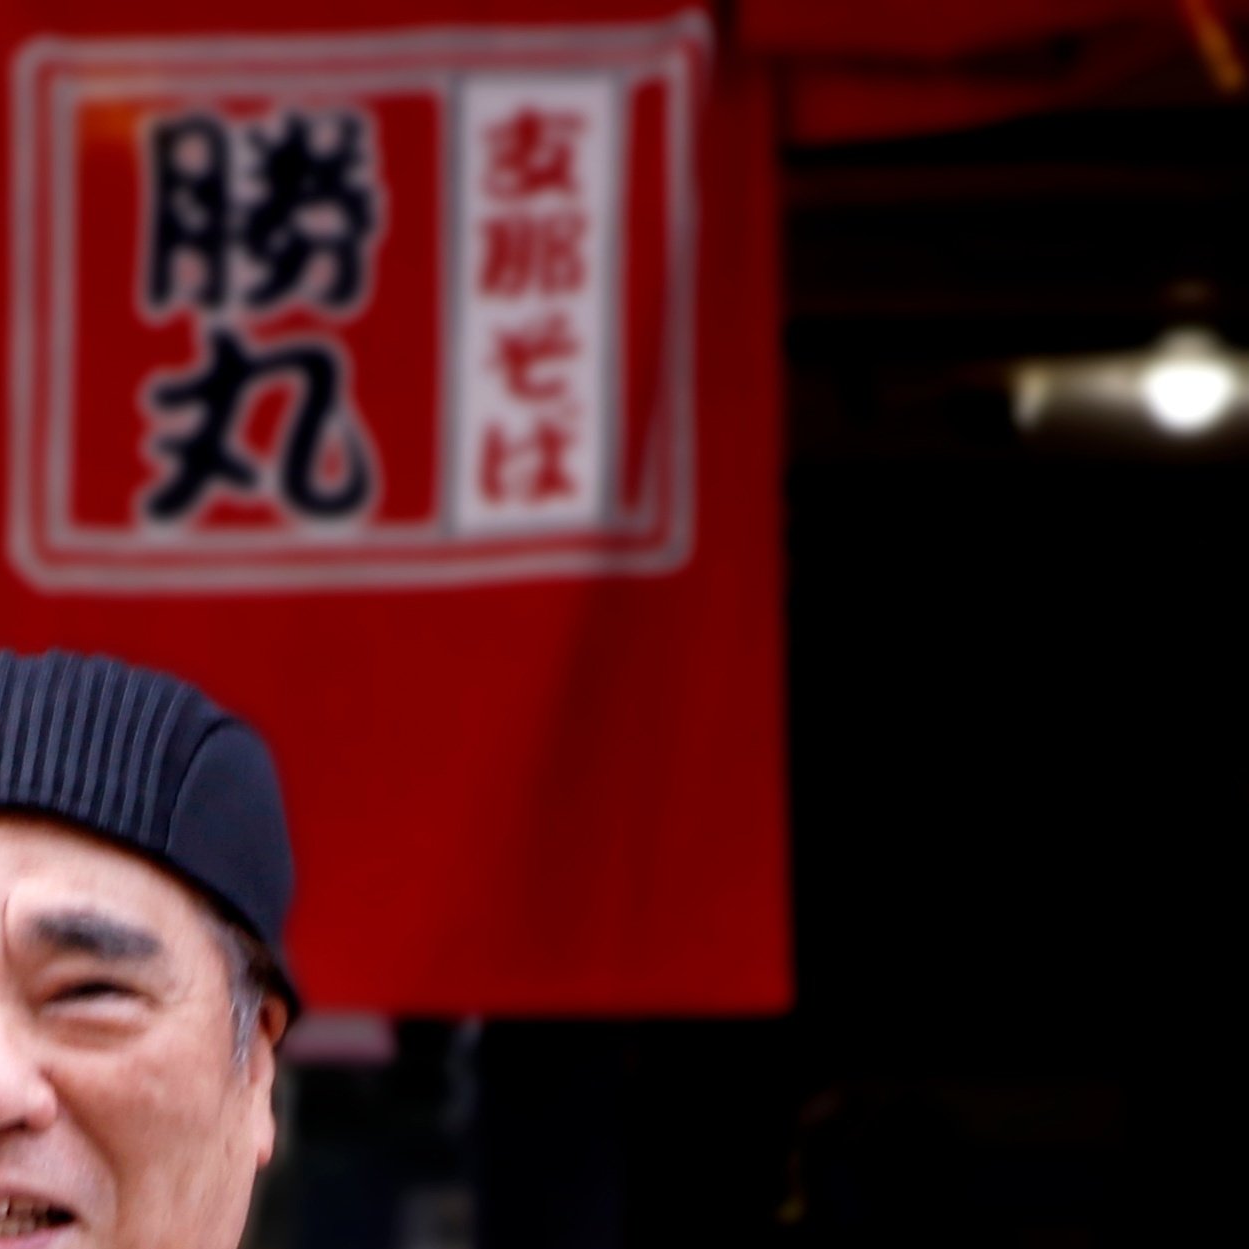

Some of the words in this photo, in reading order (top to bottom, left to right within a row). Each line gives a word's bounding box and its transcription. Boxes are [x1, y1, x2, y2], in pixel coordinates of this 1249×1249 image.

[148, 109, 375, 521] 勝丸
[478, 106, 589, 505] 支那そば
